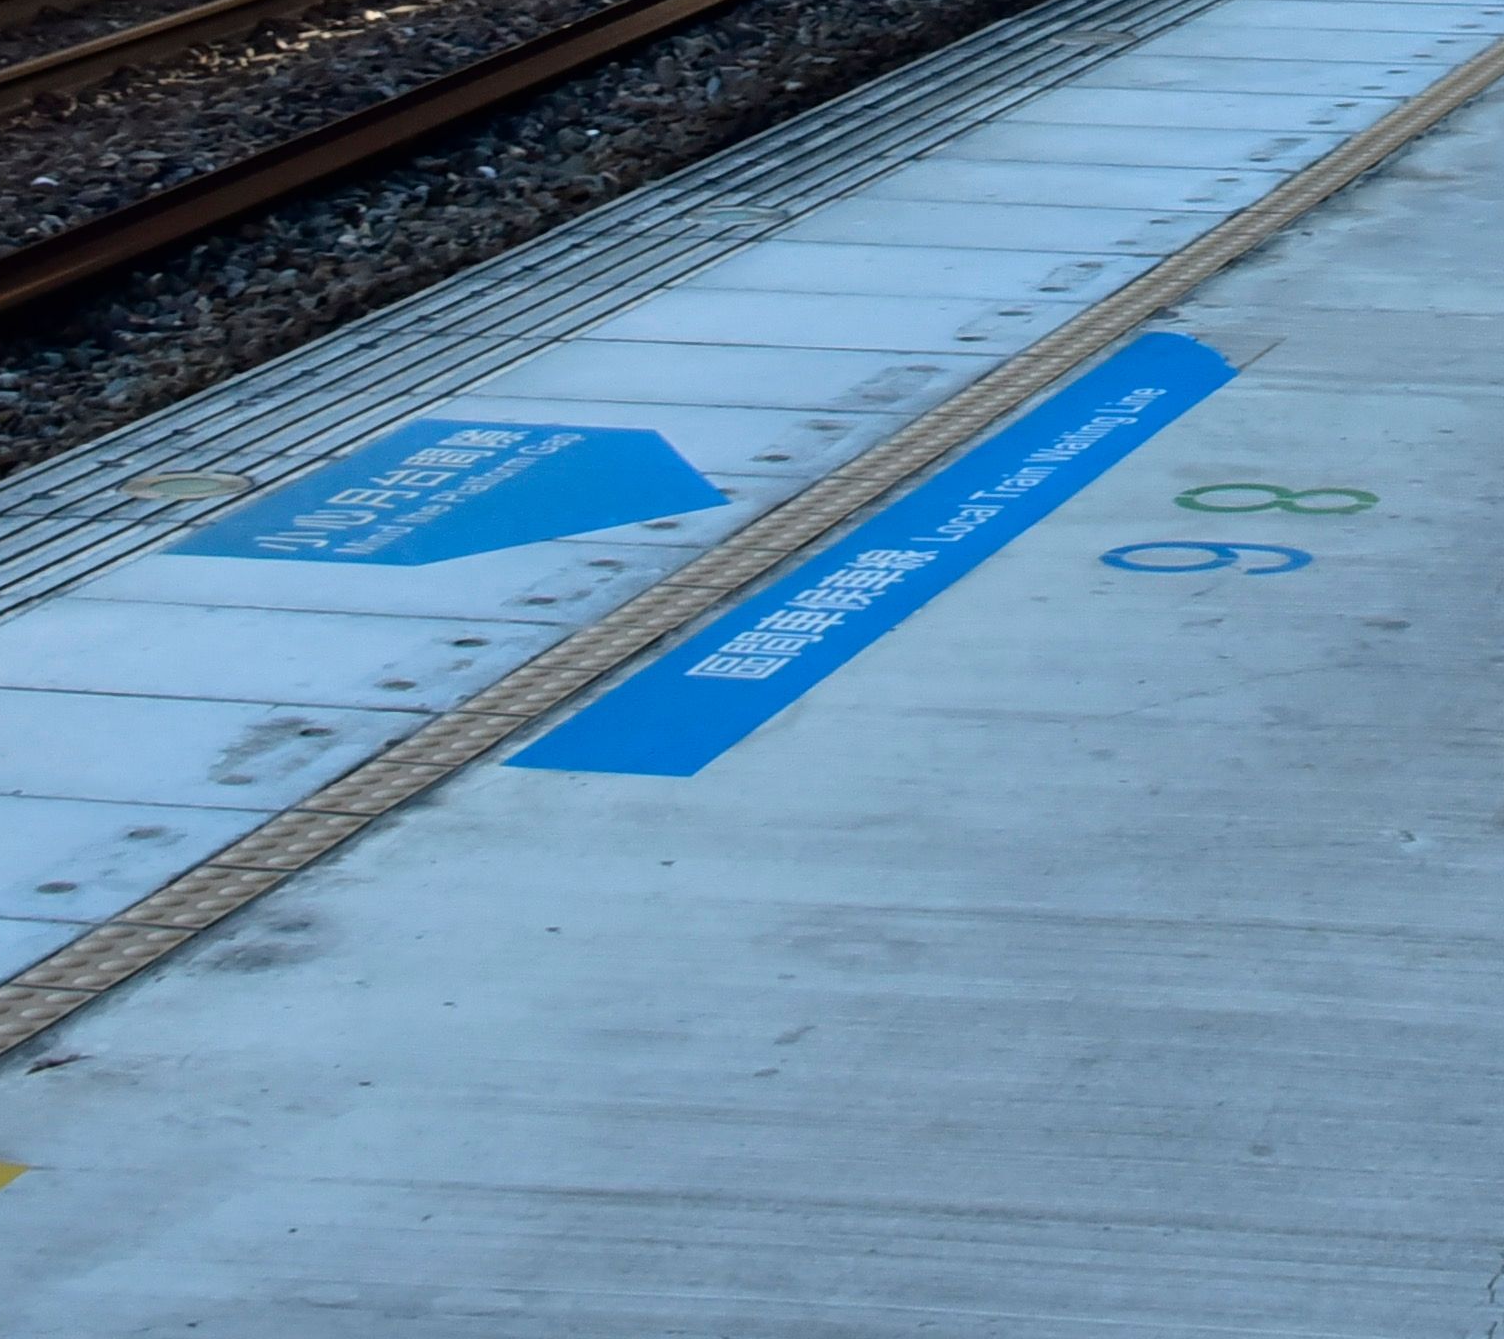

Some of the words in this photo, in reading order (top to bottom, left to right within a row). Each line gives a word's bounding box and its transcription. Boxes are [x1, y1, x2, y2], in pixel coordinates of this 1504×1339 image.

[258, 428, 532, 551] 小心月台間隙
[911, 503, 999, 543] Local
[968, 459, 1058, 511] Train
[1024, 408, 1136, 471] Waiting
[1096, 386, 1168, 426] Line
[1172, 483, 1380, 514] 8
[684, 549, 941, 680] 區間車候車線
